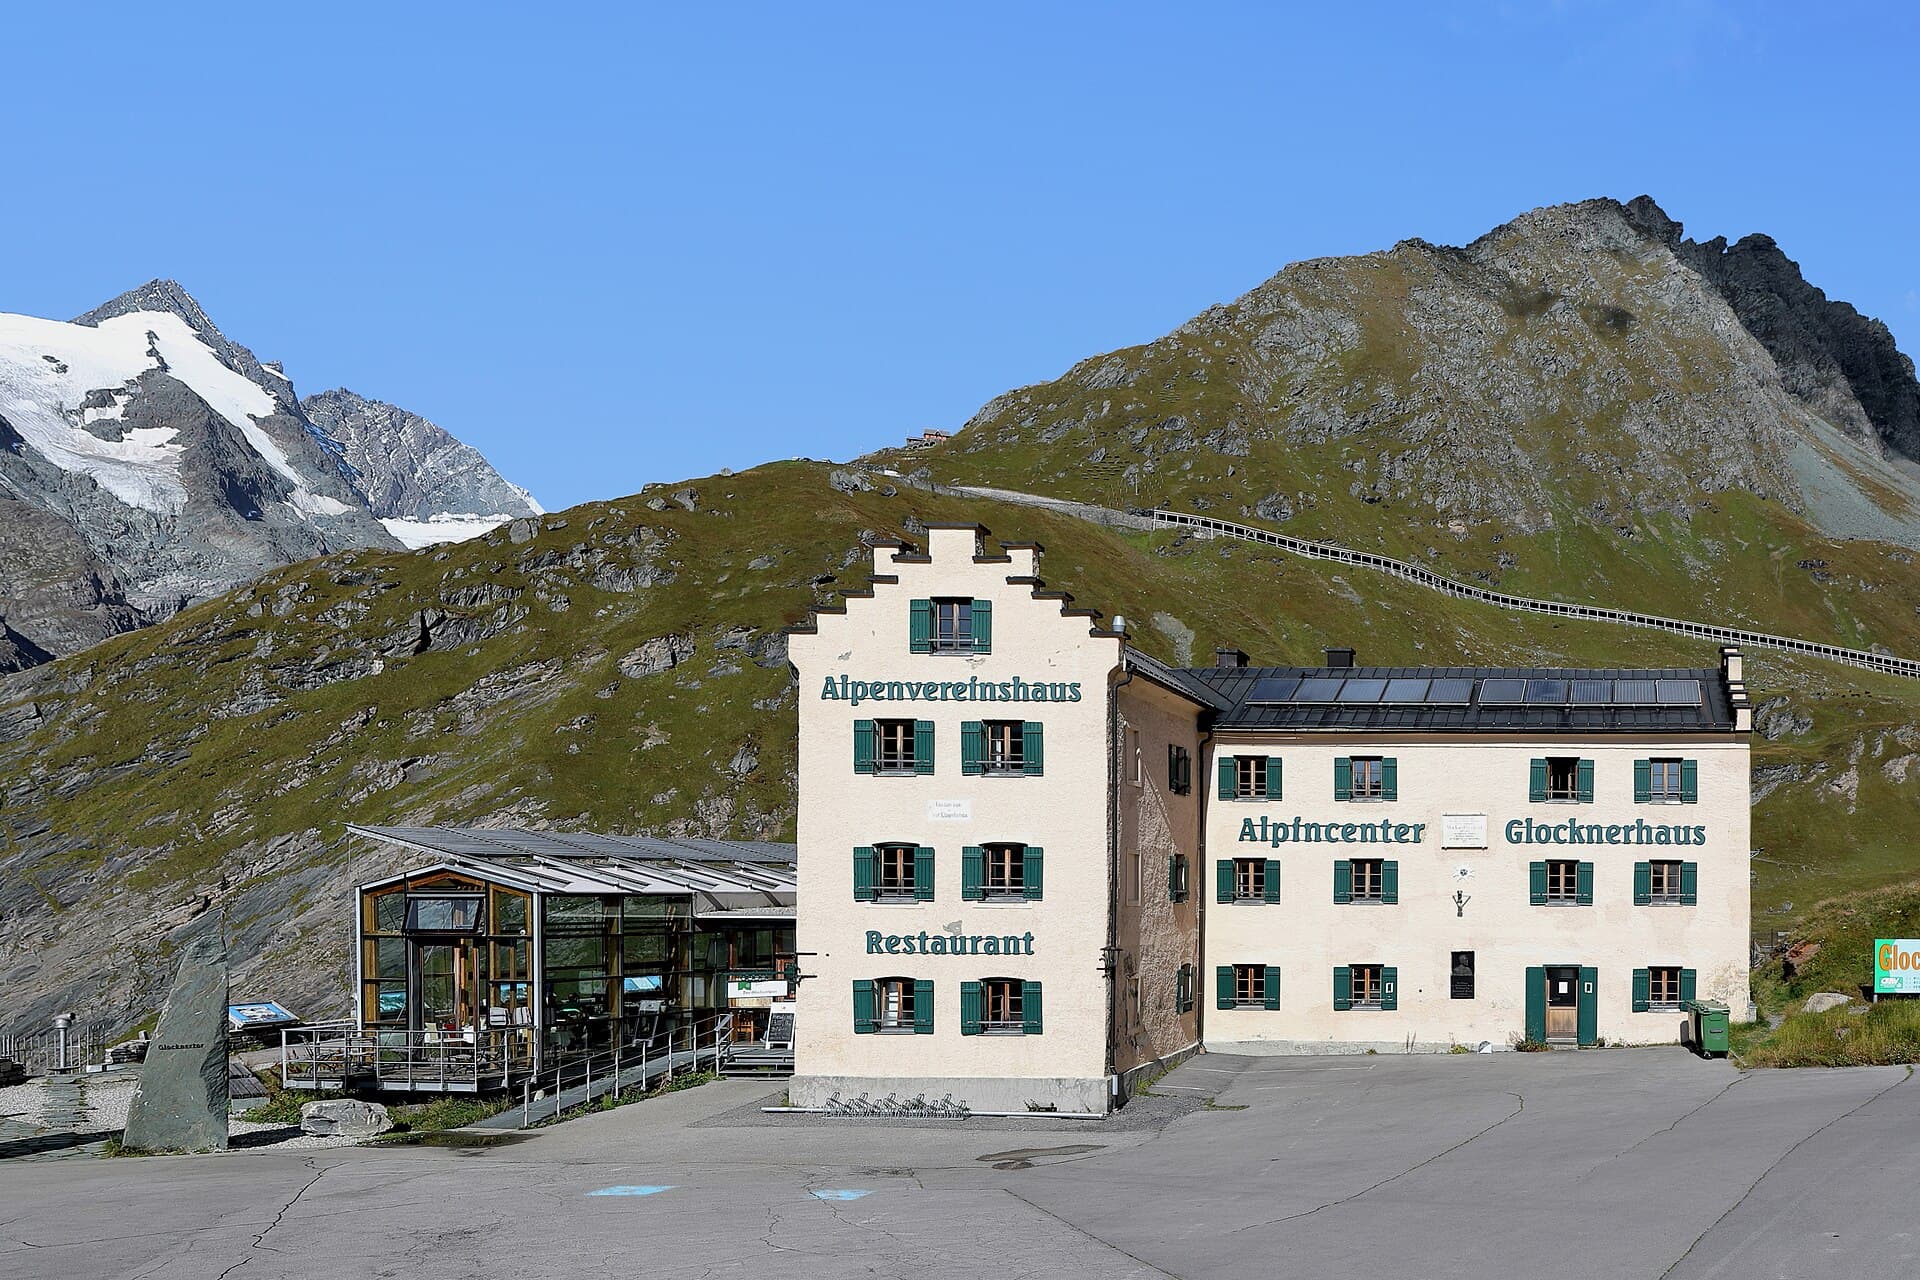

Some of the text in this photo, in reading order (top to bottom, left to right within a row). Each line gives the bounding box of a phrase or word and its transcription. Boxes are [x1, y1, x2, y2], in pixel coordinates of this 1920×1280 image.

[821, 675, 1082, 706] Alpenvereinshaus
[1238, 815, 1425, 848] Alpincenter
[1504, 817, 1706, 847] Glocknerhaus
[865, 930, 1034, 956] Restaurant
